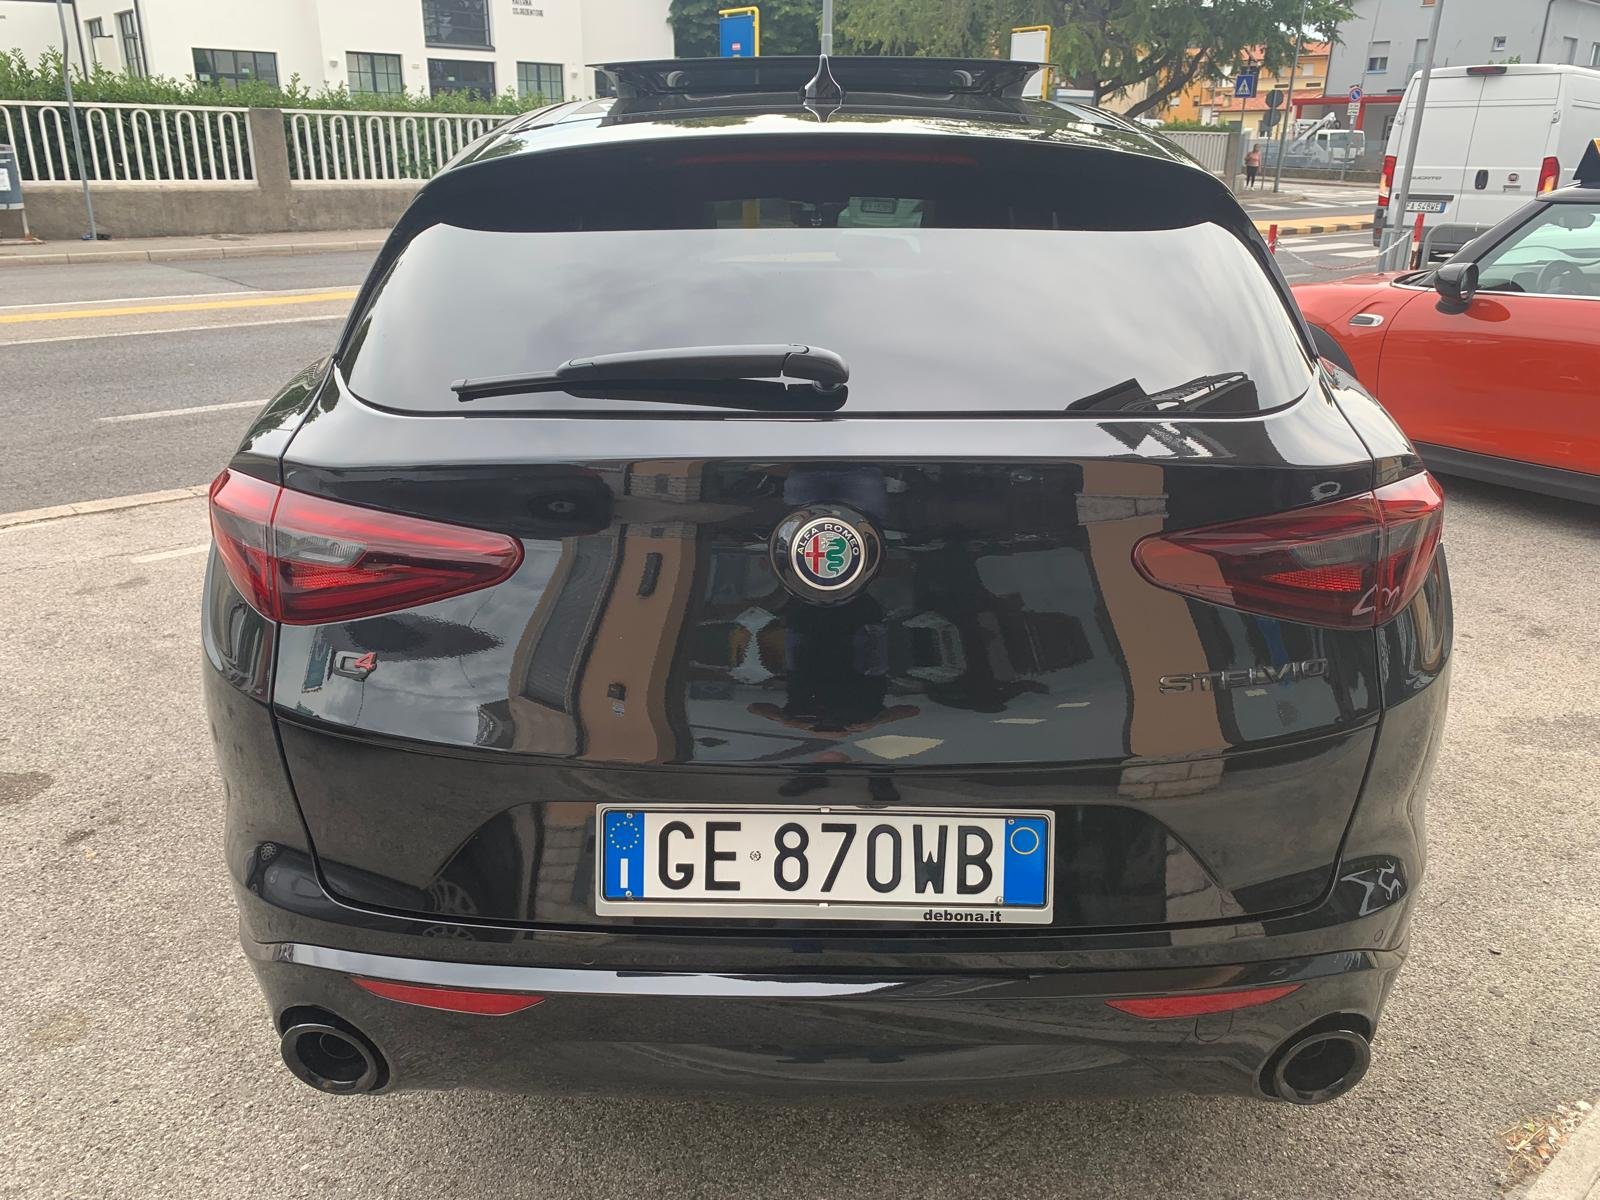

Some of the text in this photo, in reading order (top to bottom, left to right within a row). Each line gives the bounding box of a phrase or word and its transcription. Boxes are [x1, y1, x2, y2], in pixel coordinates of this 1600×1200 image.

[797, 523, 860, 556] ALFA ROMEO
[1159, 658, 1328, 695] STELVIO
[620, 858, 628, 889] I
[658, 821, 994, 895] GE 870WB
[923, 909, 1002, 923] debona.it
